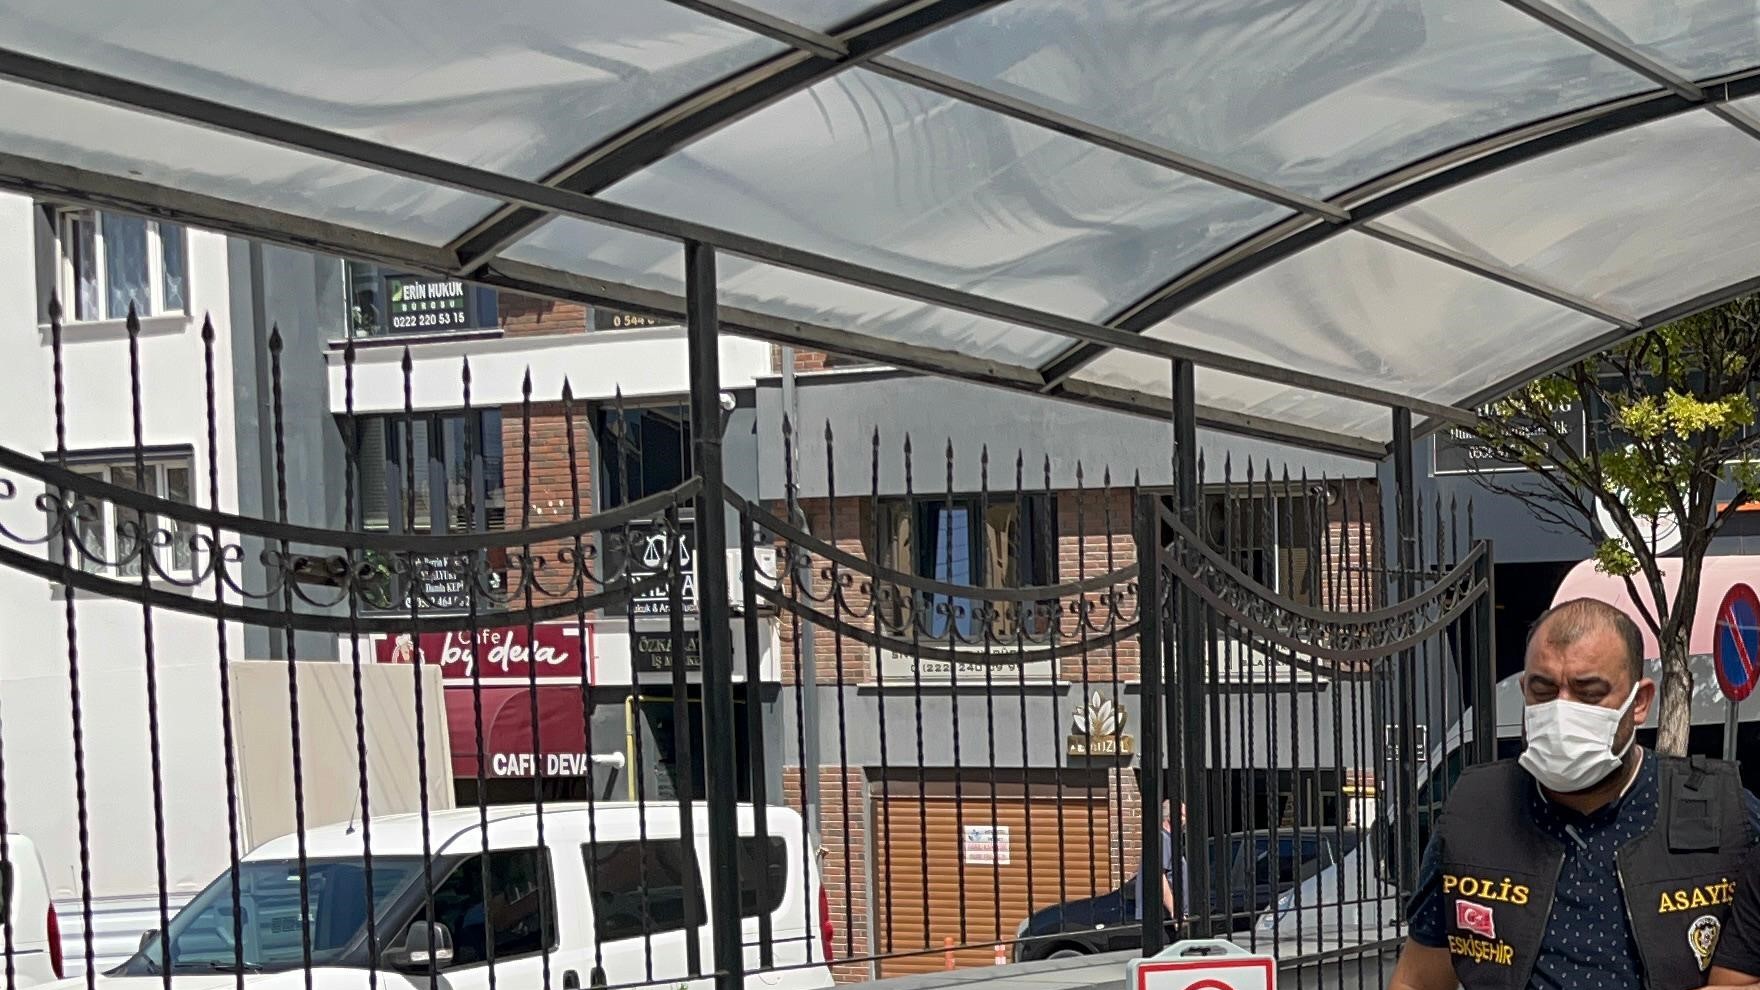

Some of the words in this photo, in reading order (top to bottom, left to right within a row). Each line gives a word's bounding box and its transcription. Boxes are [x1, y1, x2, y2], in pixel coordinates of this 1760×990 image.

[428, 282, 463, 298] HUKUK
[393, 315, 417, 328] 0222
[419, 314, 437, 326] 220
[438, 312, 451, 325] 53
[453, 311, 465, 323] 15
[458, 628, 500, 645] Cfe
[440, 631, 473, 677] by
[1442, 874, 1530, 905] POLİS
[1658, 877, 1737, 914] ASAYİŞ
[1447, 934, 1515, 966] ESKİŞEHİR
